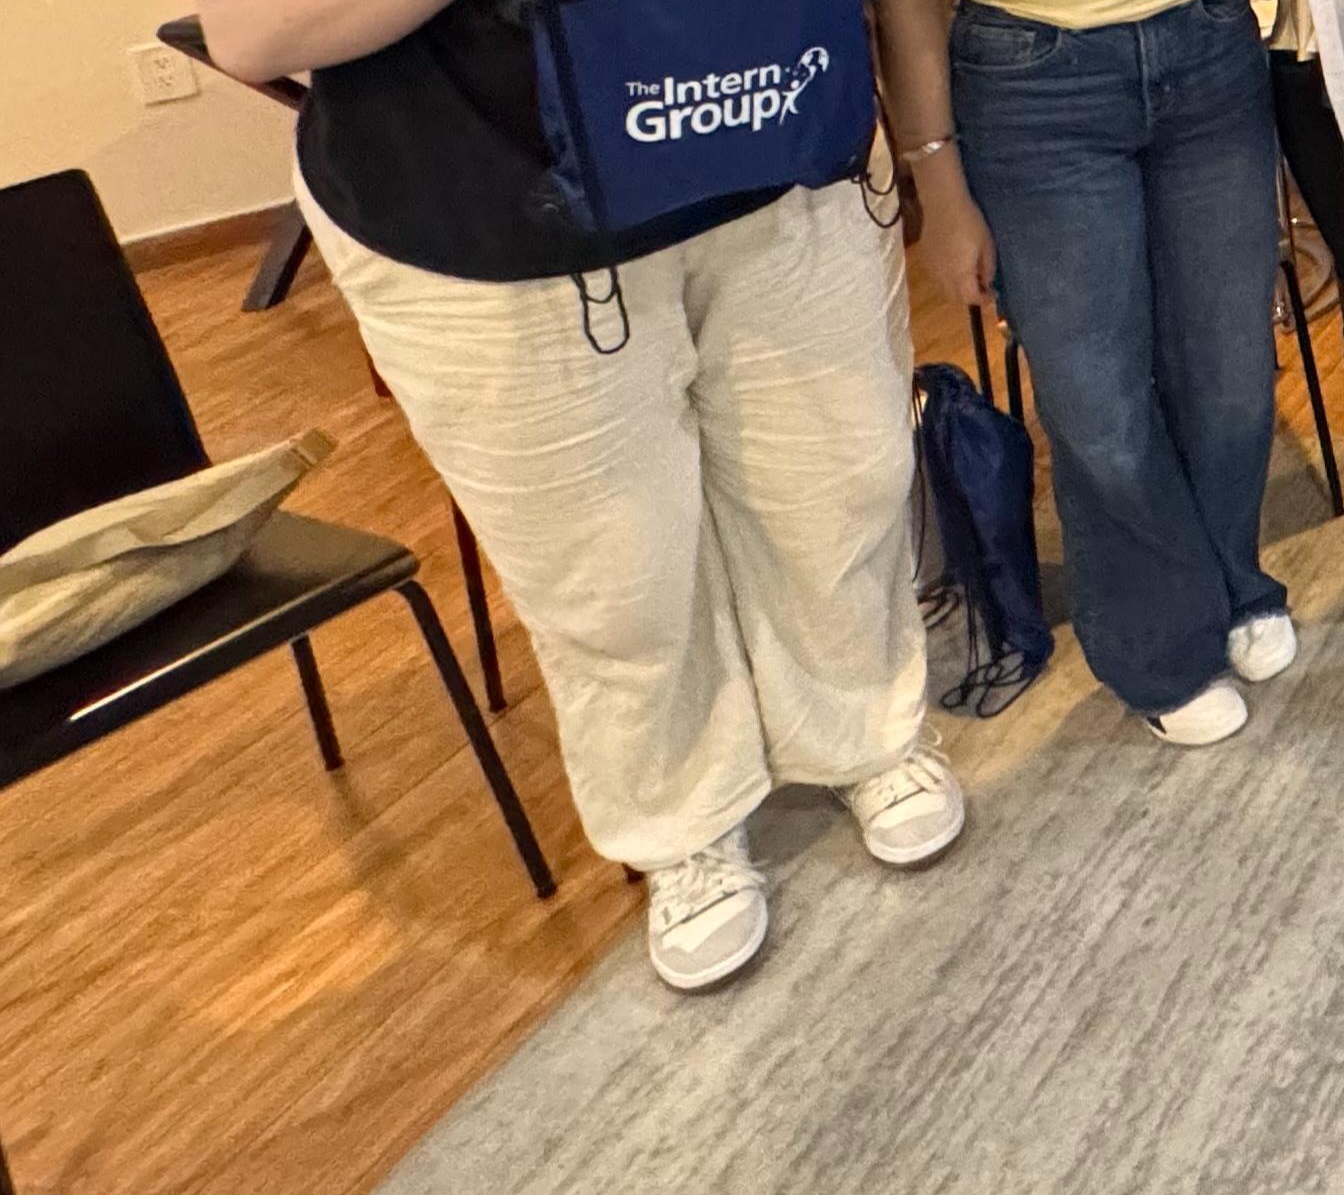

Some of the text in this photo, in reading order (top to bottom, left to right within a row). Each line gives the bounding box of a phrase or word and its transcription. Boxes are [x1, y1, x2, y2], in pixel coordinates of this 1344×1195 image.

[626, 63, 781, 106] The Intern
[625, 89, 781, 143] Group
